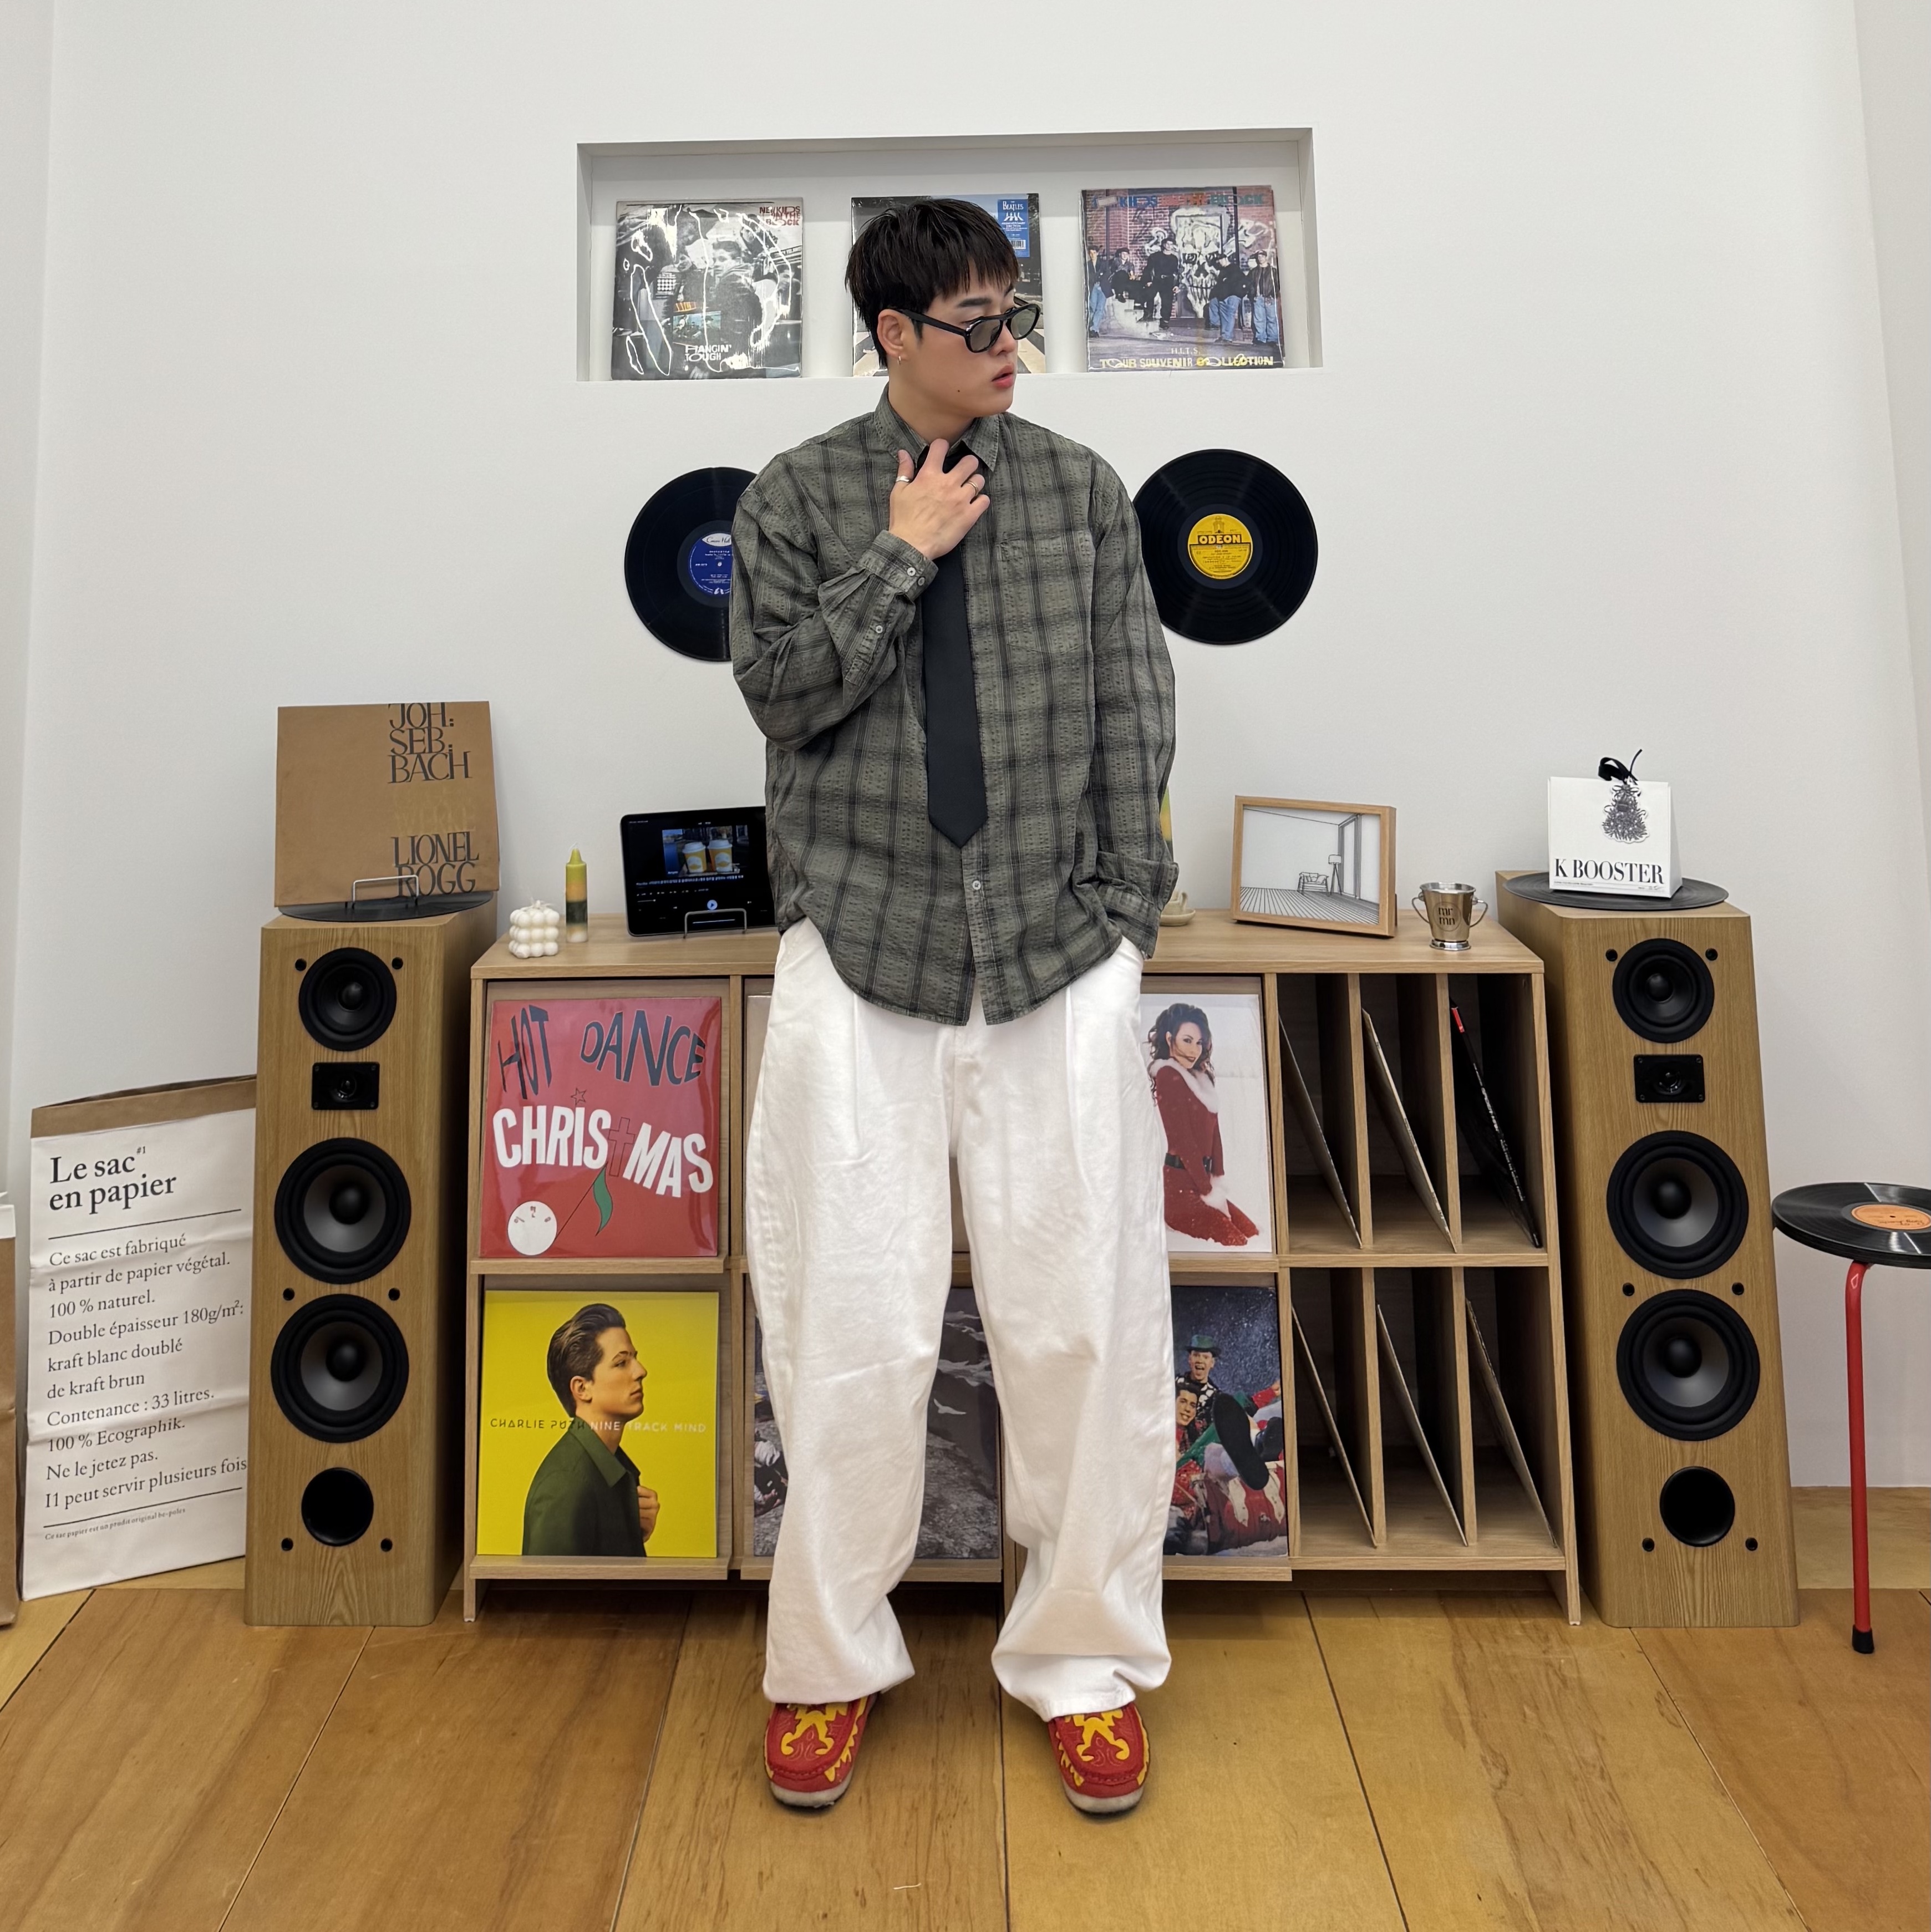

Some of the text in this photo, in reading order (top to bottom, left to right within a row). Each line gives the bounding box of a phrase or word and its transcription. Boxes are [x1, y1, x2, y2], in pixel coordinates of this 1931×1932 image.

[1002, 201, 1024, 211] BEATLES
[684, 353, 721, 362] TOUGH
[685, 344, 732, 354] HANGIN'
[1099, 358, 1137, 369] TOUR
[1139, 357, 1192, 368] SOUVENIR
[1198, 534, 1241, 545] ODEON
[387, 751, 472, 784] BACH
[390, 831, 480, 867] LIONEL
[397, 862, 476, 897] ROGG
[1554, 858, 1664, 884] K BOOSTER
[1439, 907, 1454, 916] mr
[1439, 917, 1455, 926] mn
[497, 1004, 707, 1100] HOT DANCE
[49, 1146, 146, 1184] Le sac #1
[49, 1173, 177, 1215] en papier
[49, 1232, 187, 1267] Ce sac est fabriqué
[48, 1251, 231, 1295] à partir de papier végétal.
[49, 1289, 156, 1319] 100 % naturel.
[48, 1323, 106, 1345] Double
[109, 1315, 179, 1339] épaisseur
[48, 1337, 184, 1372] kraft blanc doublé
[47, 1374, 146, 1399] de kraft brun
[47, 1401, 140, 1427] Contenance
[151, 1393, 170, 1410] 33
[174, 1389, 215, 1406] litres.
[49, 1417, 186, 1452] 100 % Ecographik.
[490, 1417, 545, 1429] CHARLIE
[590, 1421, 621, 1431] NINE
[628, 1422, 668, 1432] TRACK
[674, 1423, 707, 1433] MIND
[45, 1451, 159, 1481] Ne le jetez pas.
[64, 1488, 99, 1511] peut
[102, 1476, 146, 1498] servir
[149, 1465, 217, 1492] plusieurs
[221, 1456, 247, 1474] fois
[131, 1512, 157, 1523] original
